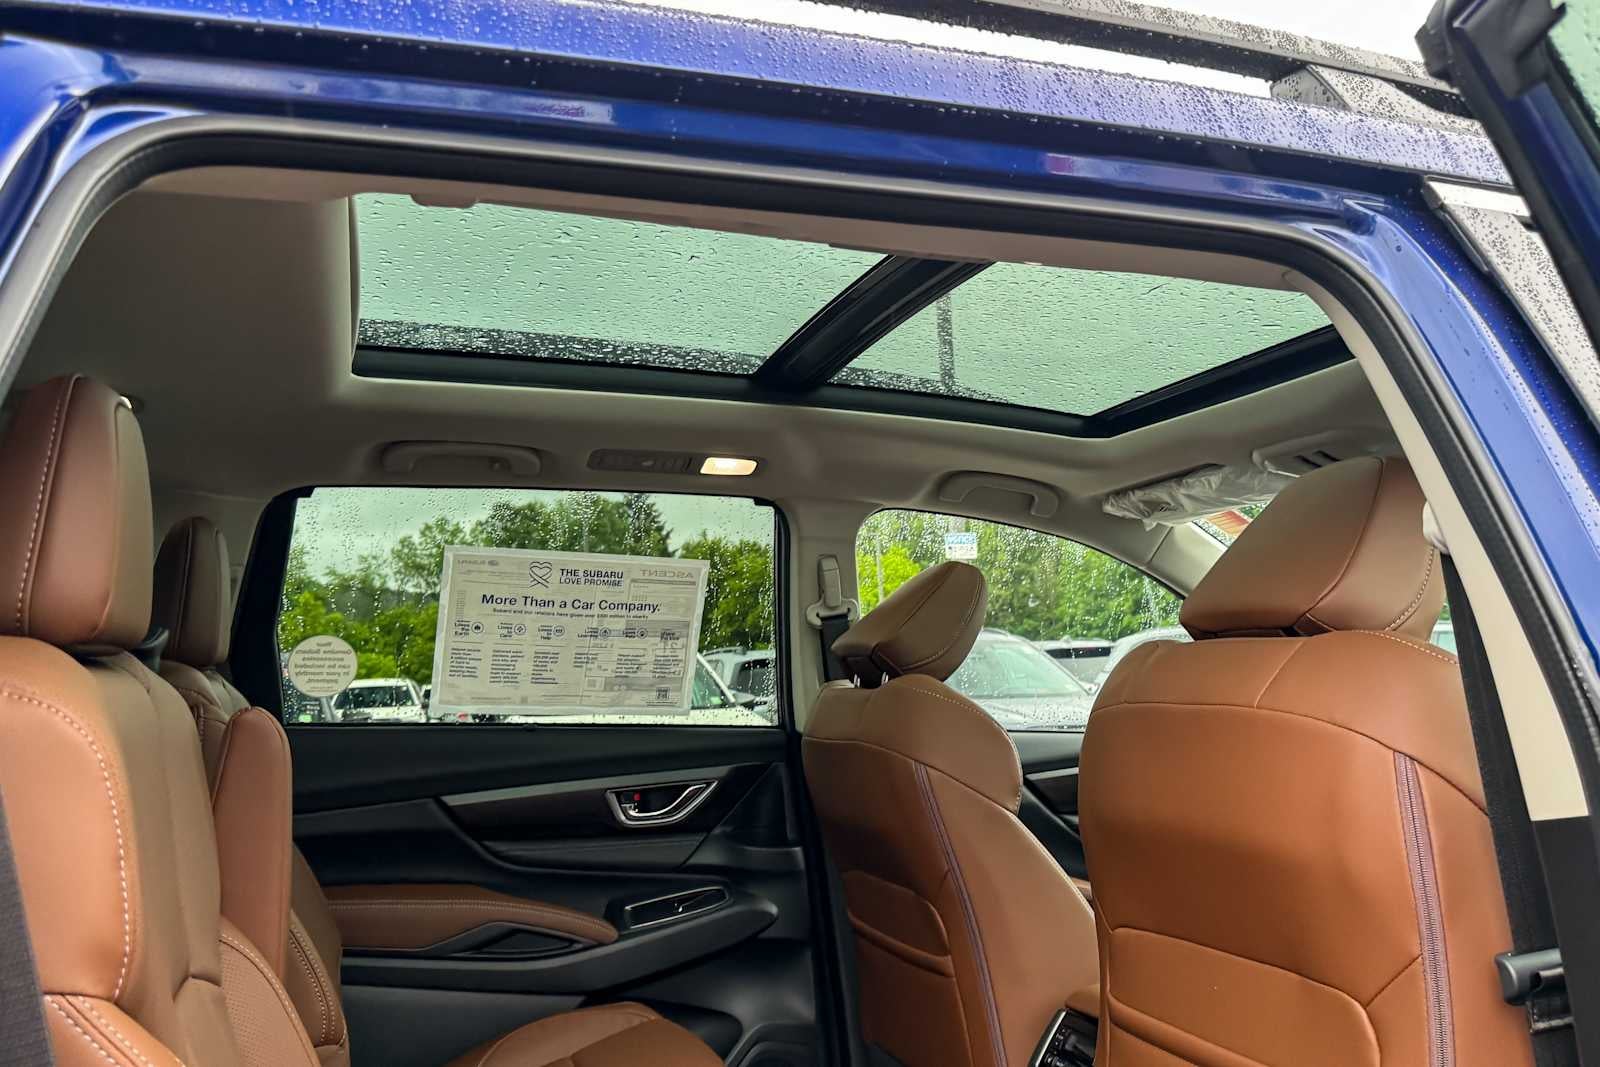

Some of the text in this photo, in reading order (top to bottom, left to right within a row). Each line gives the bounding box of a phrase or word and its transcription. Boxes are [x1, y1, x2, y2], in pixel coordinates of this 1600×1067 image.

[560, 568, 624, 580] THE SUBARU
[559, 576, 623, 588] LOVE PROMISE
[481, 594, 517, 607] More
[523, 596, 556, 609] Than
[559, 600, 568, 609] a
[571, 598, 596, 611] Car
